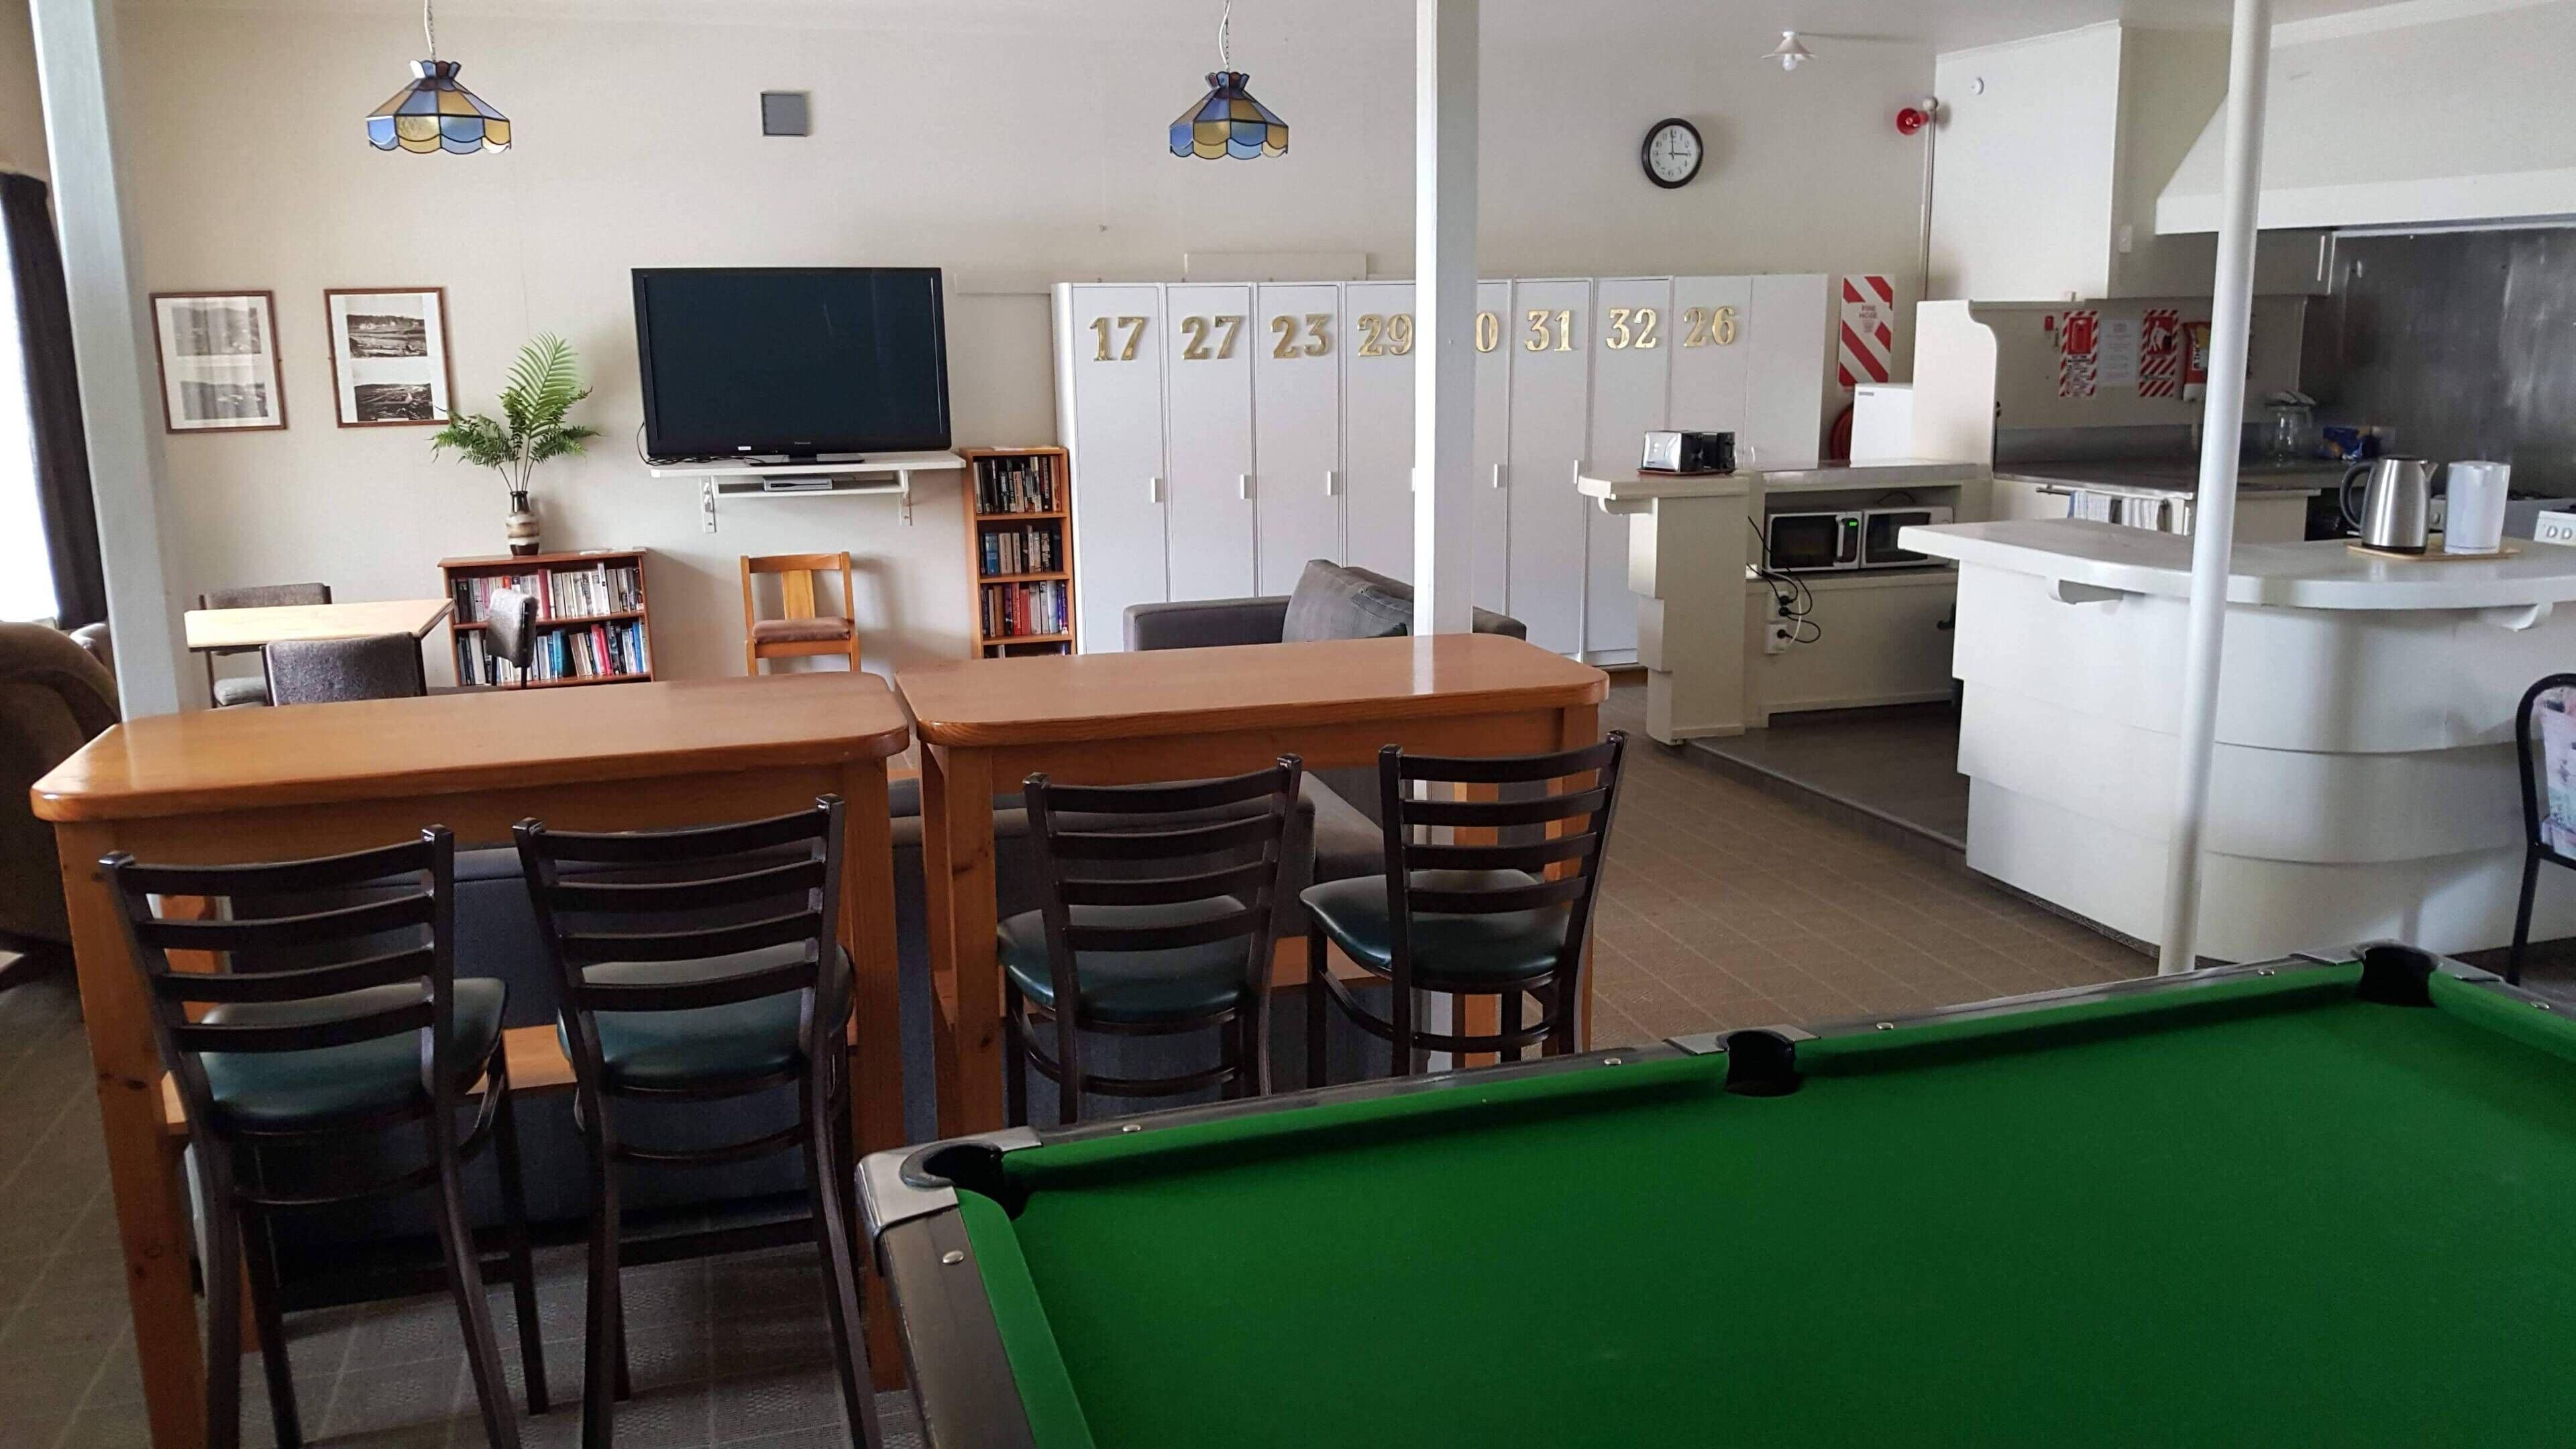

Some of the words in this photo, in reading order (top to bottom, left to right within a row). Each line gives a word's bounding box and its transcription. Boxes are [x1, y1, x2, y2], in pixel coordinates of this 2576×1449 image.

[1089, 316, 1146, 361] 17
[1180, 315, 1242, 360] 27
[1271, 313, 1331, 359] 23
[1357, 313, 1413, 357] 29
[1475, 311, 1499, 353] 0
[1524, 310, 1572, 352] 31
[1606, 307, 1657, 350] 32
[1683, 306, 1736, 348] 26
